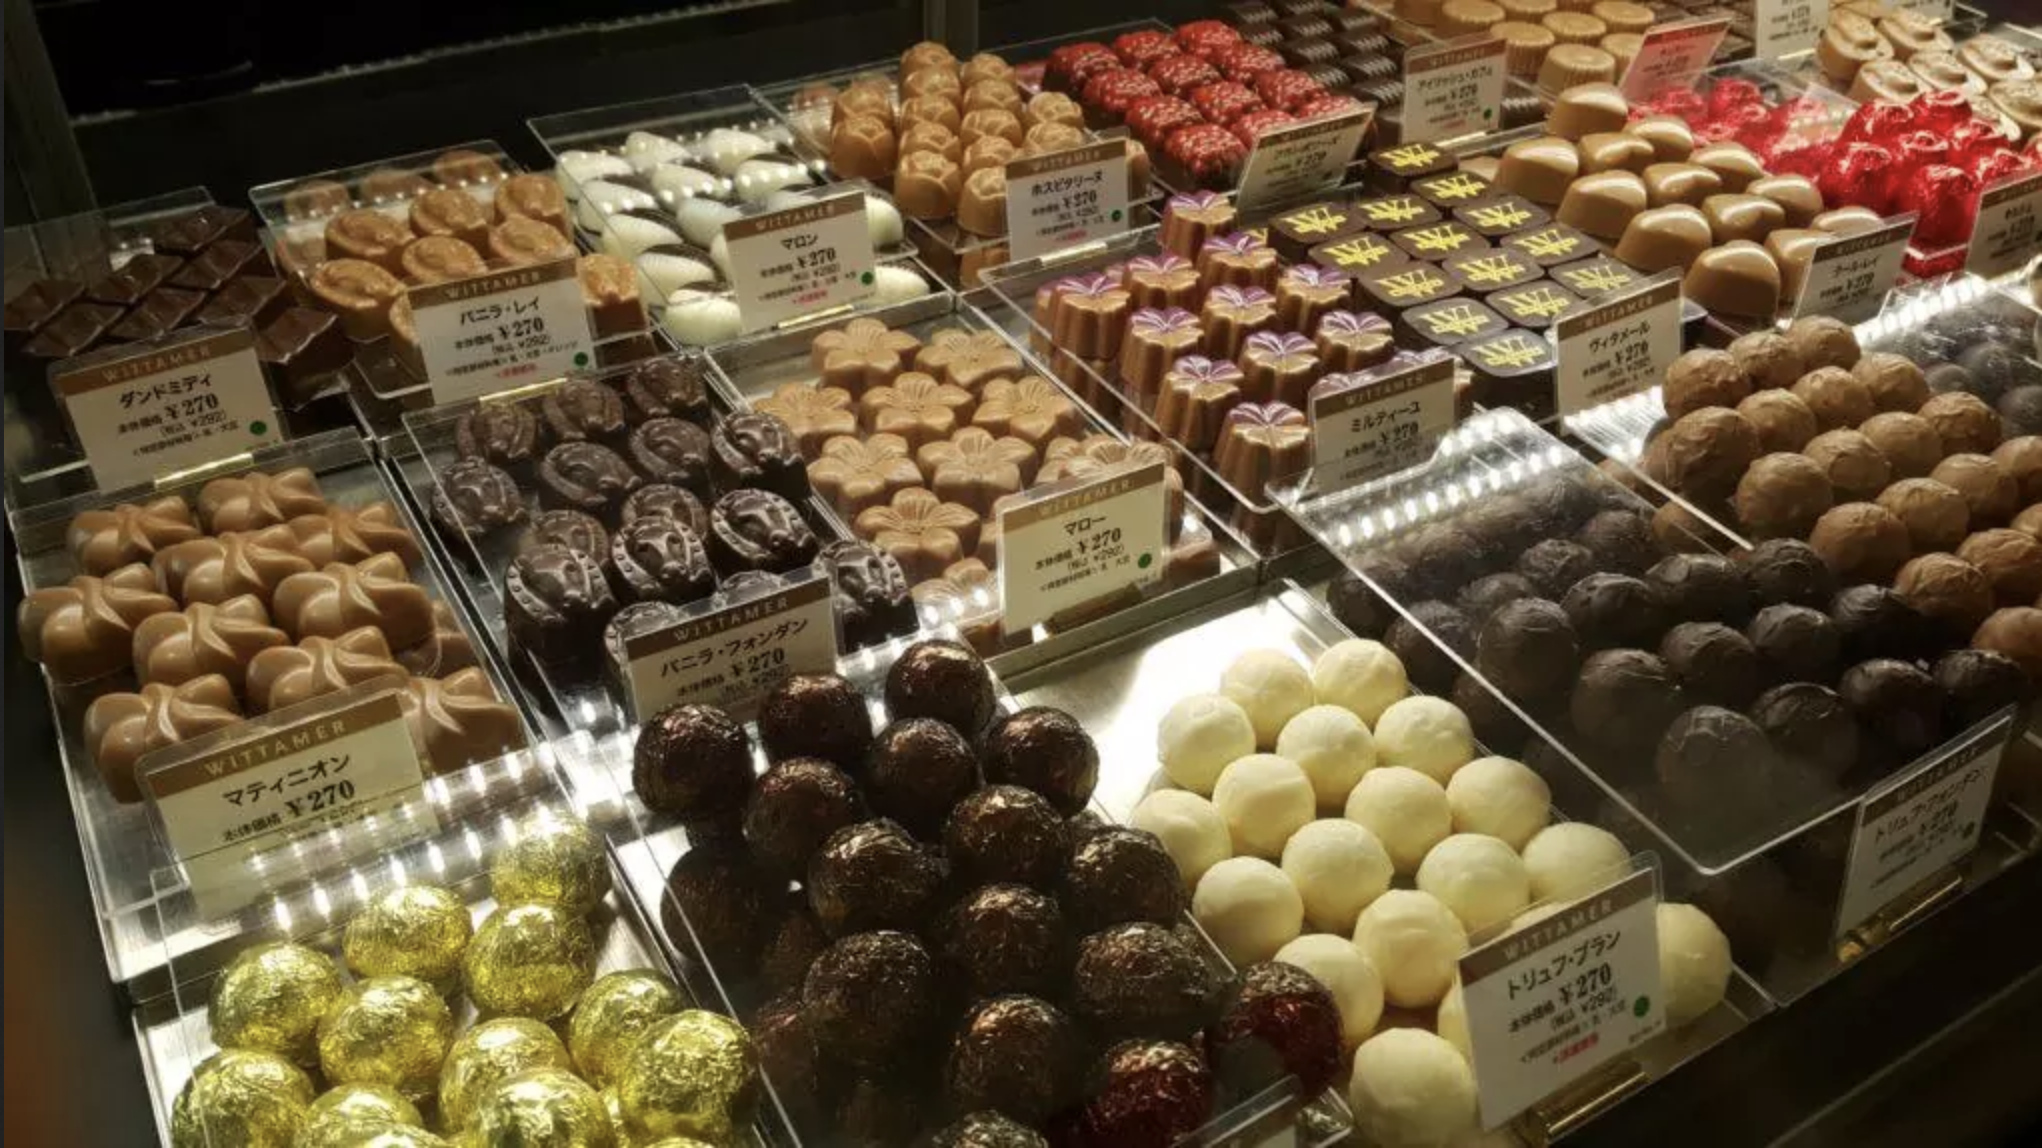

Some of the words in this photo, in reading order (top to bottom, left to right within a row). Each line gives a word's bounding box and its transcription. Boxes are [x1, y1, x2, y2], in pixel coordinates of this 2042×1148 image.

[756, 203, 836, 231] WITTAMER
[780, 234, 819, 250] マロン
[797, 247, 837, 268] ¥270
[446, 271, 541, 299] WITTAMER
[460, 296, 540, 326] バニラ・レイ
[497, 317, 545, 341] ¥270
[102, 347, 212, 383] WITTAMER
[119, 373, 213, 410] ダンドミディ
[164, 393, 220, 421] ¥270
[1038, 479, 1129, 516] WITTAMER
[1064, 516, 1107, 537] マロー
[1077, 527, 1122, 555] ¥270
[673, 597, 788, 641] WITTAMER
[661, 618, 808, 678] バニラ・フォンダン
[730, 647, 786, 677] ¥270
[204, 719, 347, 777] WITTAMER
[222, 753, 351, 808] マティニオン
[284, 779, 356, 818] ¥270
[1504, 898, 1613, 961] WITTAMER
[1507, 931, 1622, 1001] トリュフ・ブラン
[1558, 962, 1612, 1007] ¥270
